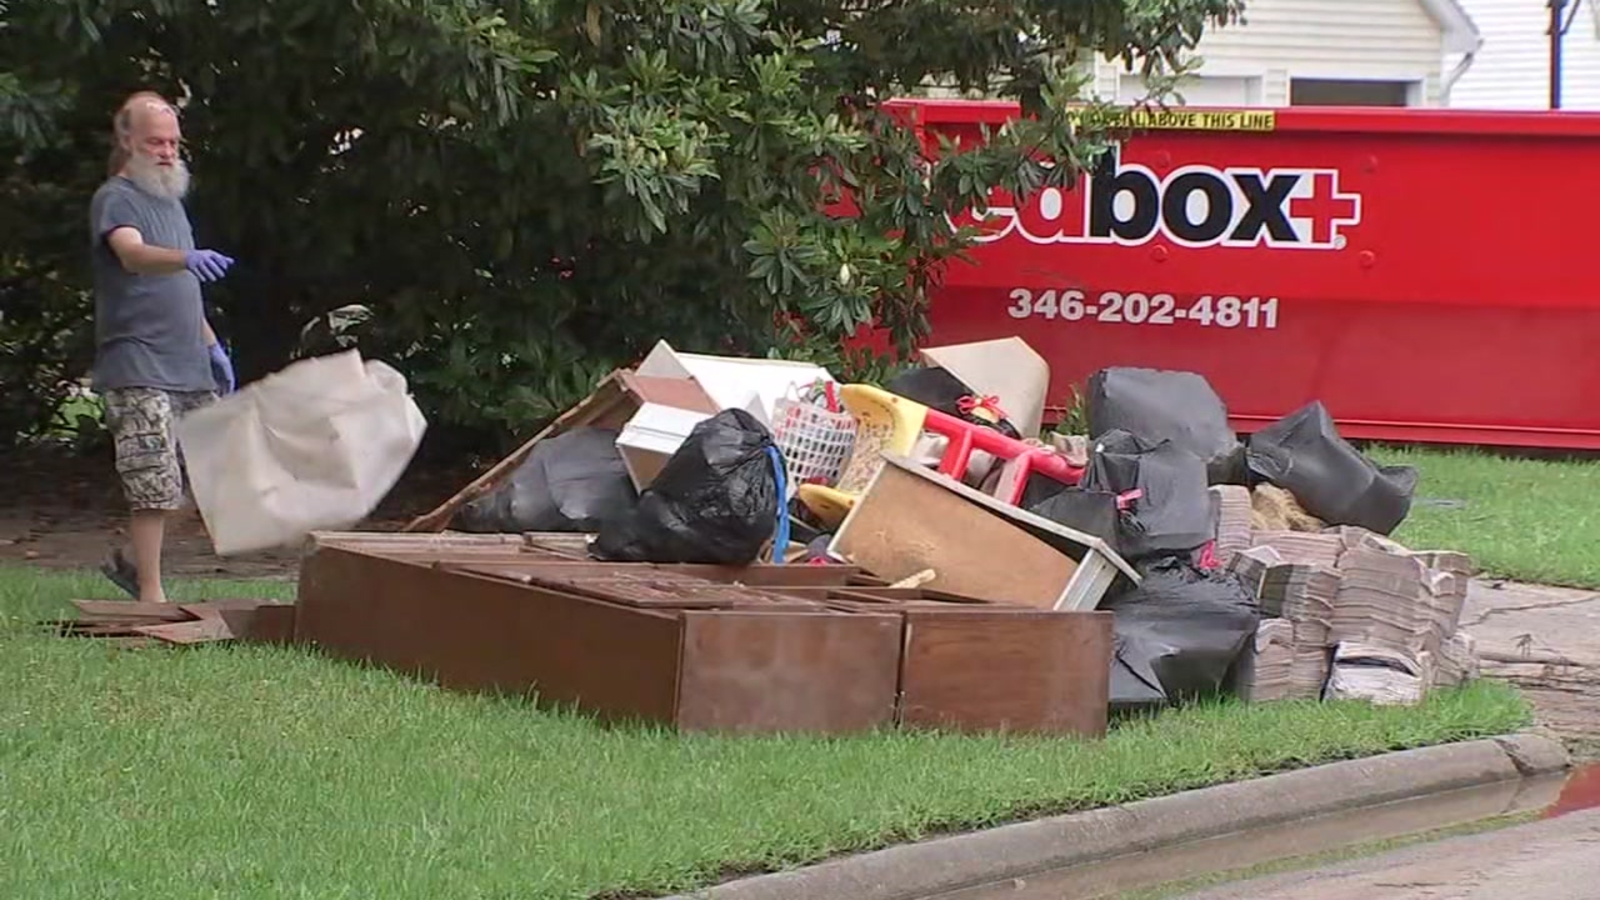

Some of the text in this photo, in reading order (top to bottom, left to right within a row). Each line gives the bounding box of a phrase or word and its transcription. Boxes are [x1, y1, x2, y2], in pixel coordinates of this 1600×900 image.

[1149, 113, 1197, 127] ABOVE
[1202, 114, 1234, 128] THIS
[1240, 115, 1273, 129] LINE
[1008, 288, 1279, 328] 346-202-4811
